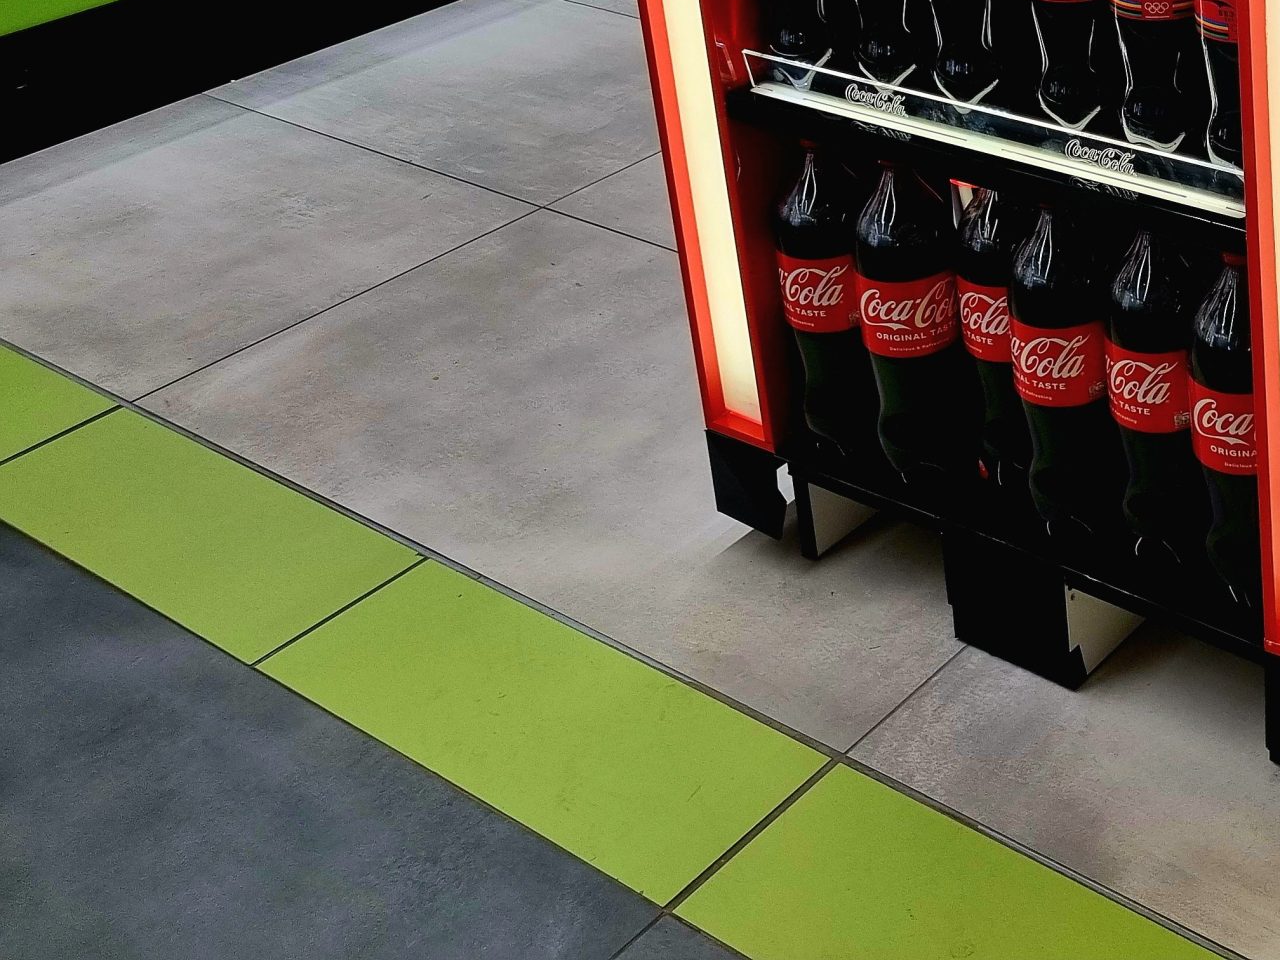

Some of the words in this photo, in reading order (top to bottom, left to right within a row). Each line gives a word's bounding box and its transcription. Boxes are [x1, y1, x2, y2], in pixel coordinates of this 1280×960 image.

[845, 83, 908, 118] Coca-Cola
[1065, 139, 1137, 177] Coca-Cola
[860, 279, 957, 331] Coca-Col
[796, 308, 827, 318] TASTE
[876, 331, 927, 342] ORIGINAL
[967, 331, 993, 346] TASTE
[1010, 334, 1091, 379] a-Cola
[1032, 380, 1067, 391] TASTE
[1120, 401, 1151, 416] TASTE
[1210, 445, 1257, 458] ORIGINA
